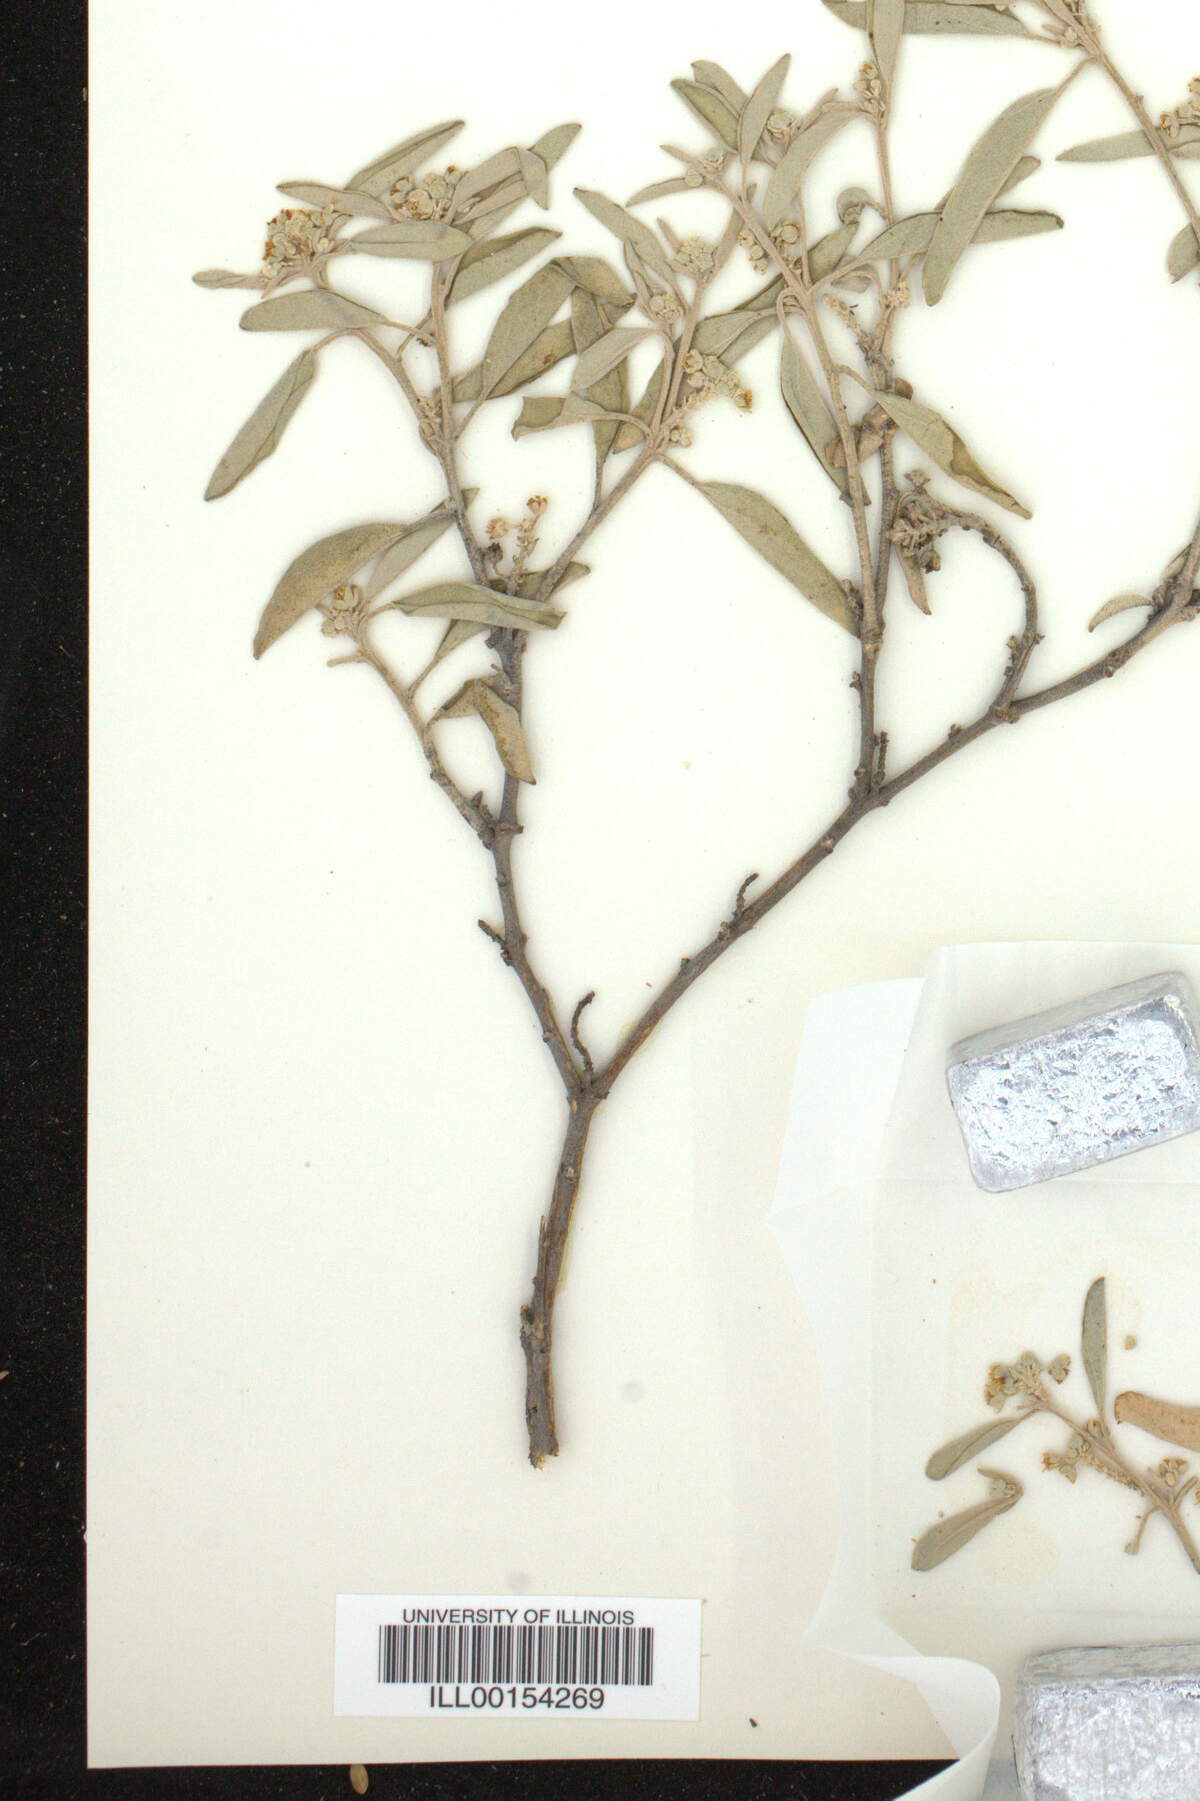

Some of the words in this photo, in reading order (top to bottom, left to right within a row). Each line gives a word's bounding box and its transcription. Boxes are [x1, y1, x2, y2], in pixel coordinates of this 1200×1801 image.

[403, 1609, 519, 1624] UNIVERSITY
[524, 1609, 550, 1623] OF
[557, 1610, 635, 1625] ILLINOIS
[429, 1686, 605, 1709] ILL00154269
